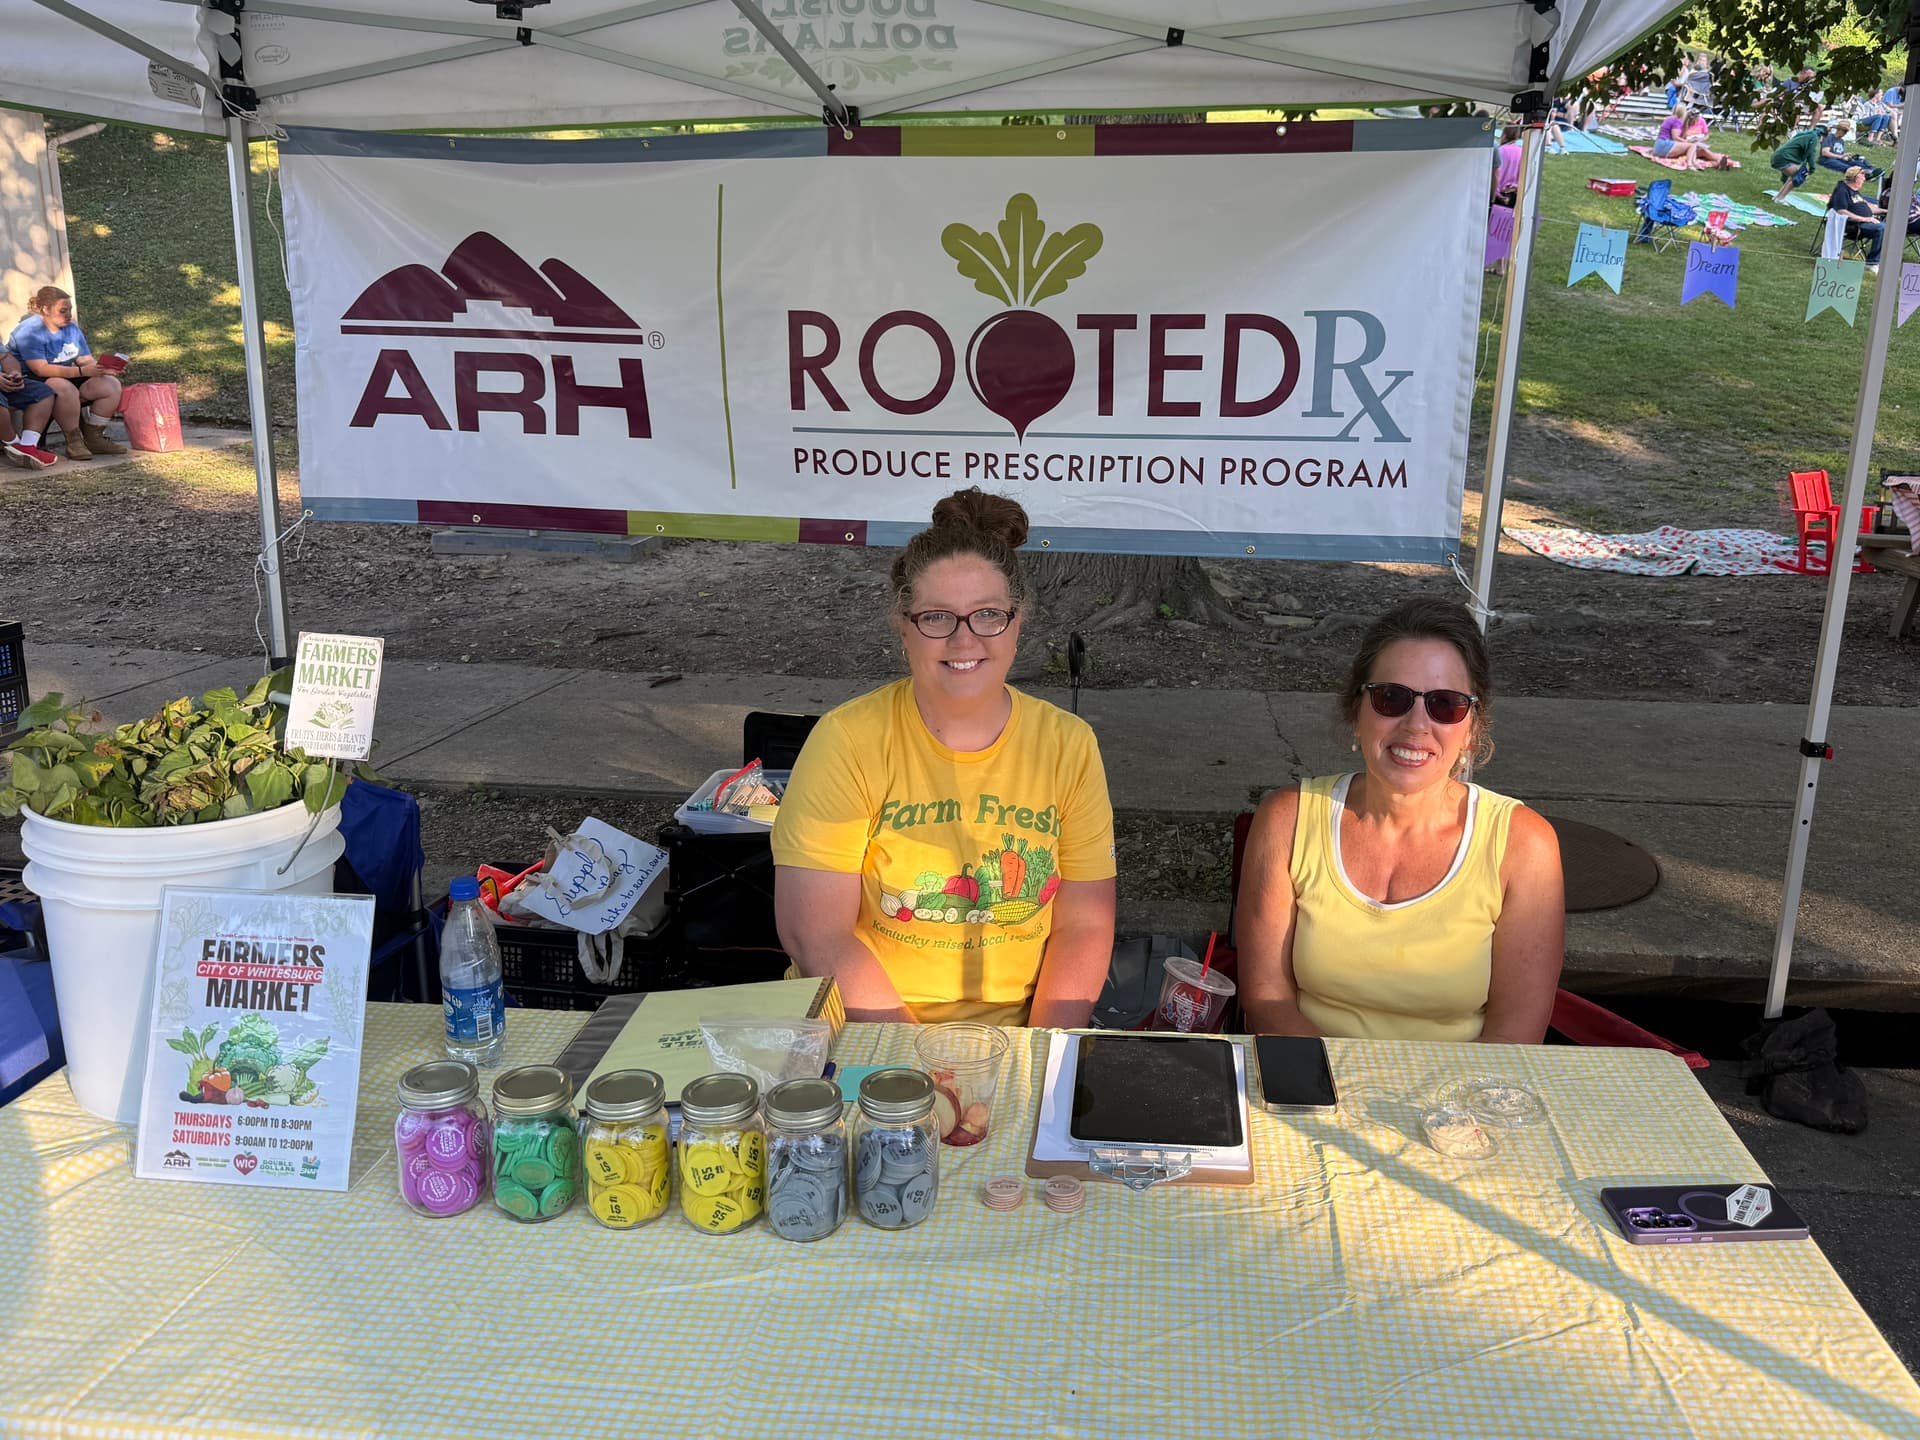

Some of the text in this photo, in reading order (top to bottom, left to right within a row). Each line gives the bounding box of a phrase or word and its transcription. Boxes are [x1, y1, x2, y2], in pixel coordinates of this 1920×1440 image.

[1575, 231, 1624, 267] Freedom
[1689, 248, 1736, 276] Dream
[1812, 265, 1856, 300] Peace
[349, 348, 652, 439] ARH
[794, 447, 1408, 488] PRODUCE PRESCRIPTION PROGRAM
[301, 642, 378, 666] FARMERS
[298, 663, 376, 690] MARKET
[342, 732, 366, 744] PLANTS
[873, 793, 1063, 838] Farm Fresh
[622, 890, 634, 904] to
[634, 869, 651, 891] each
[872, 920, 929, 948] Kentucky
[933, 935, 975, 951] raised,
[977, 932, 1008, 949] local
[202, 939, 325, 968] FARMERS
[197, 964, 323, 981] CITY OF WHITESBURG
[205, 978, 315, 1012] MARKET
[174, 1111, 313, 1131] THURSDAYS 6:00PM TO 8:30PM
[172, 1129, 313, 1151] SATURDAYS 9:00AM TO 12:00PM
[163, 1157, 191, 1168] ARH
[235, 1158, 256, 1169] WIC
[259, 1164, 296, 1172] DOLLARS
[262, 1159, 293, 1167] DOUBLE
[701, 1166, 715, 1181] $5
[712, 1209, 728, 1221] $5
